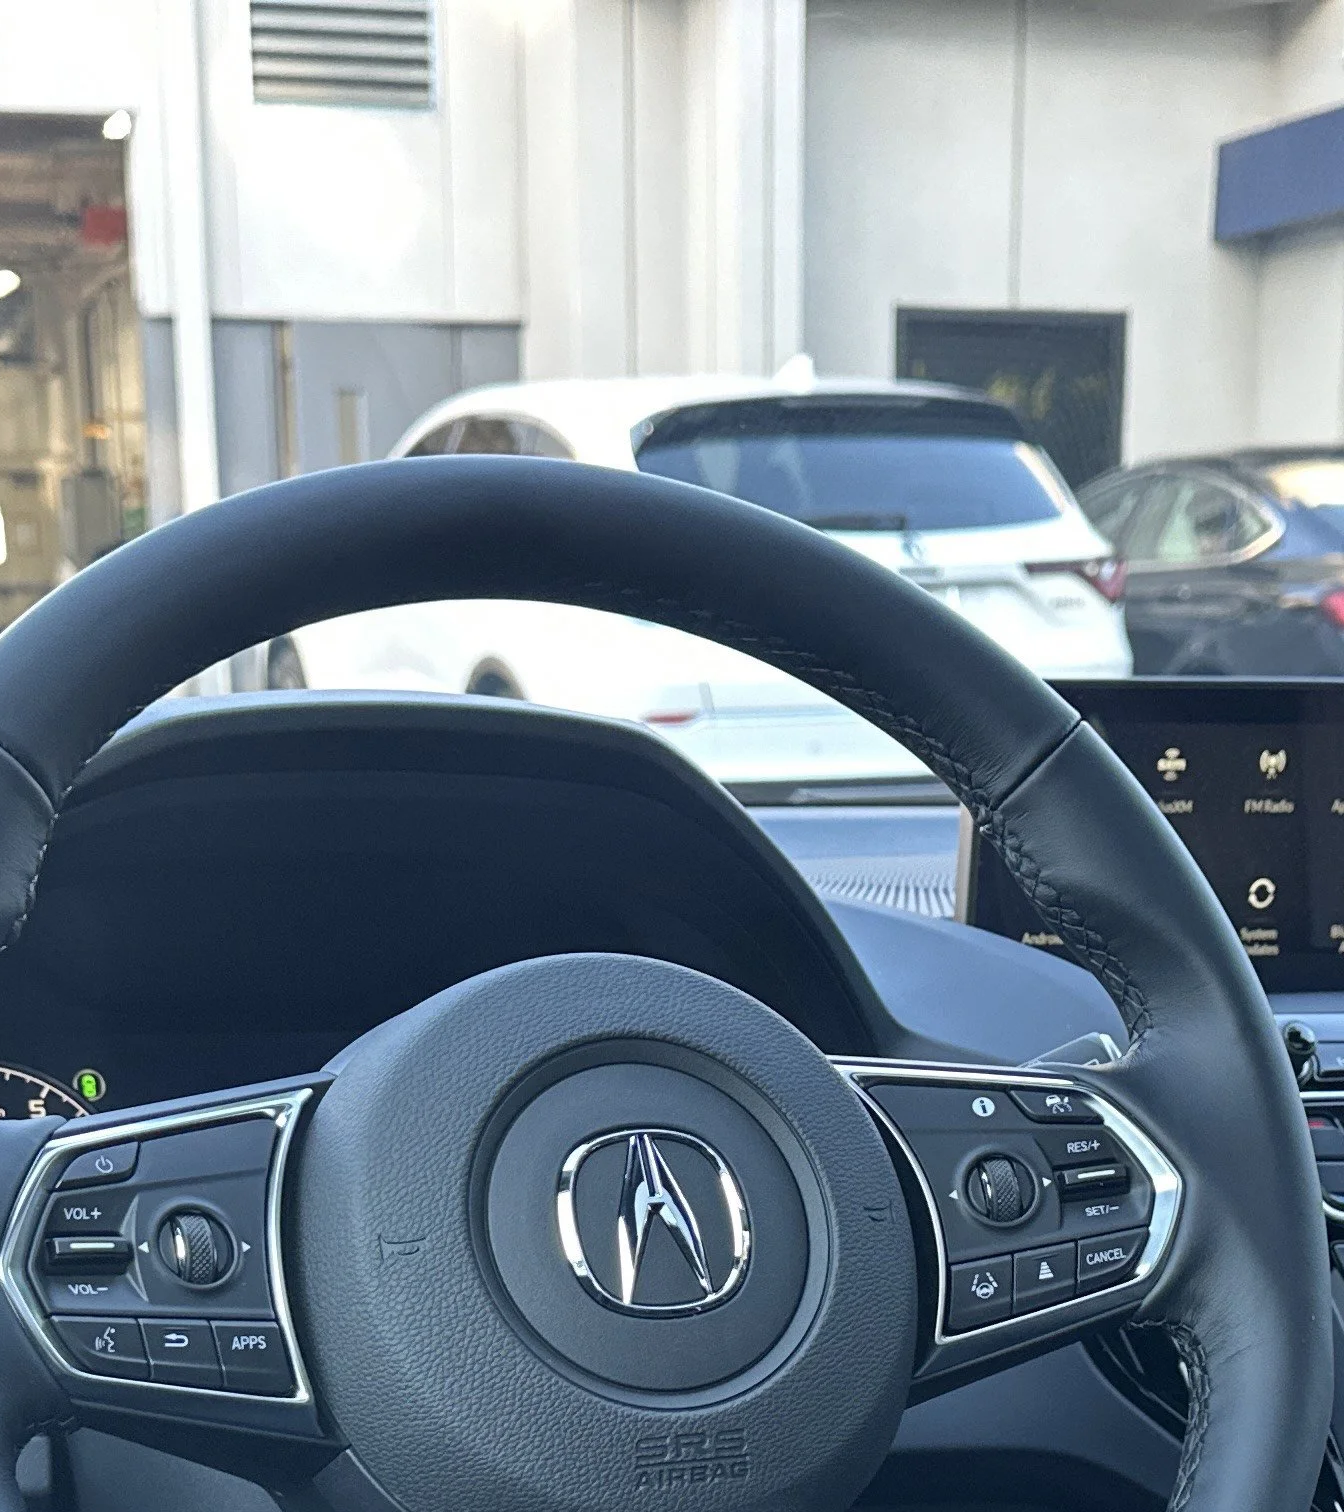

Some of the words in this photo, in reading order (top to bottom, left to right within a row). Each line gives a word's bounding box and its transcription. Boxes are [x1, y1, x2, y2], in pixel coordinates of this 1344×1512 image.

[1264, 799, 1295, 814] Radio
[28, 1099, 47, 1118] 5
[63, 1207, 103, 1221] VOL+
[1086, 1247, 1127, 1267] CANCEL
[231, 1335, 267, 1351] APPS
[636, 1428, 748, 1463] SRS
[635, 1462, 751, 1490] AIRBAG
